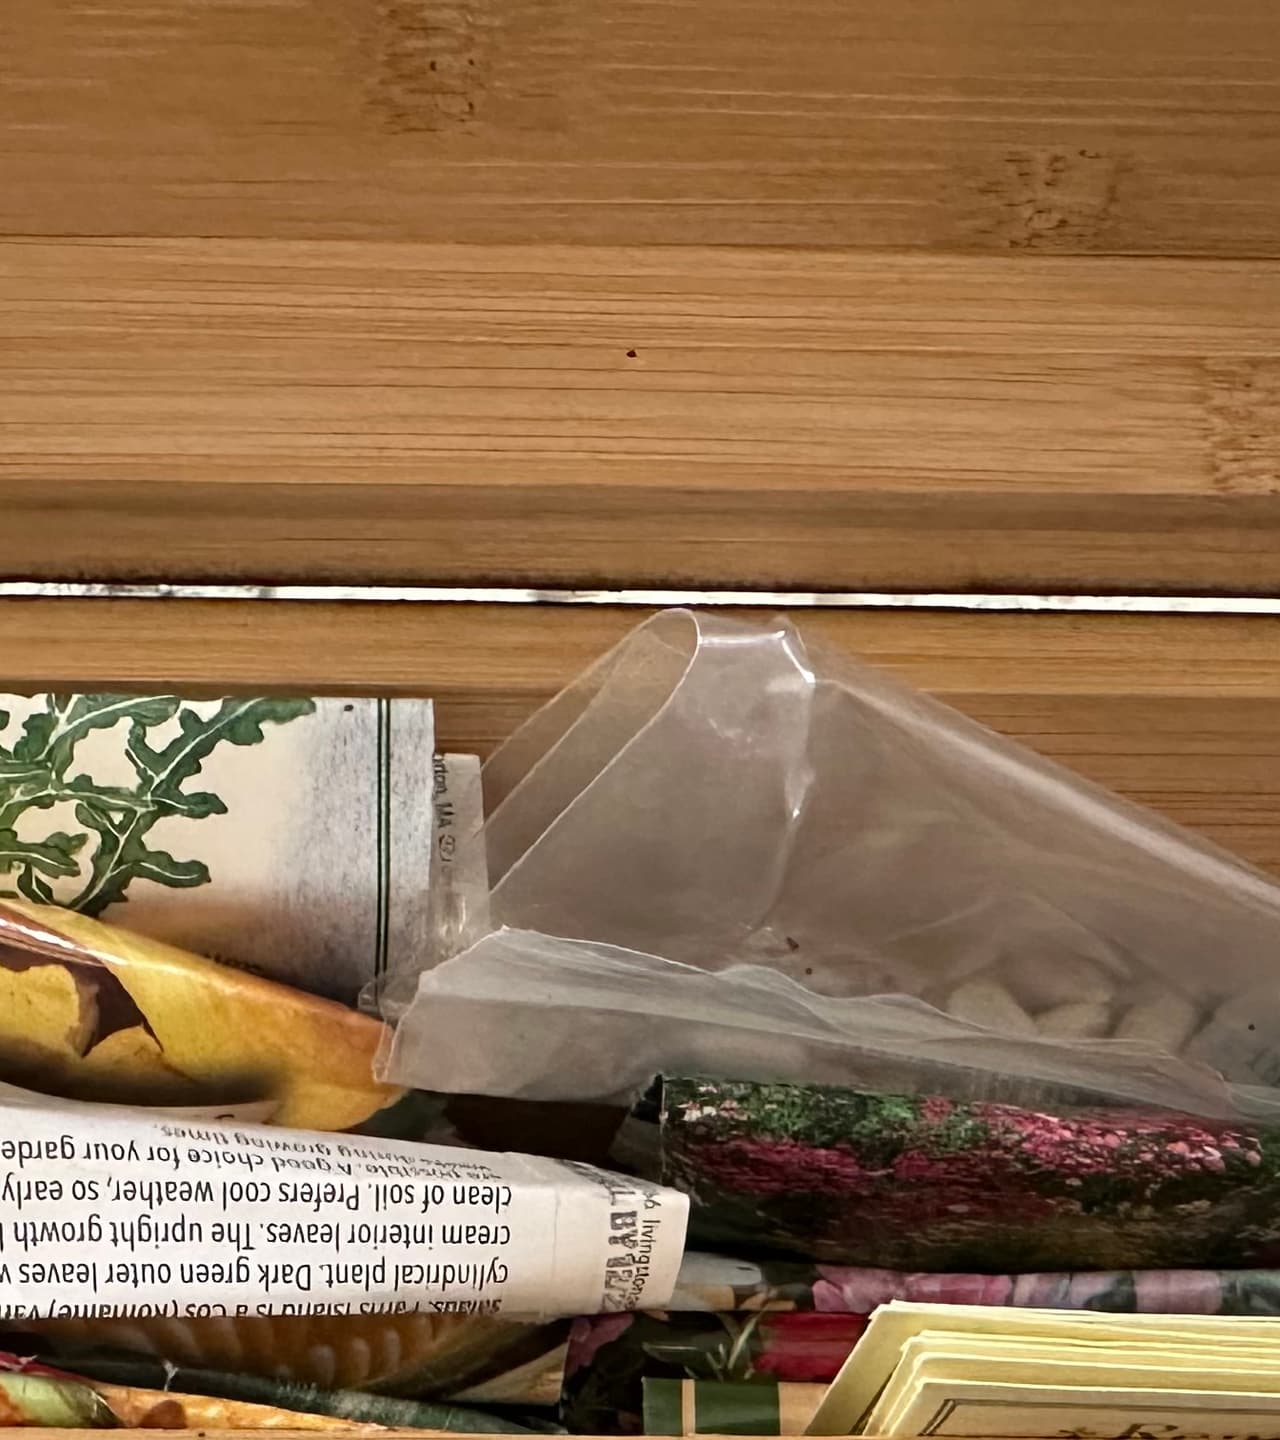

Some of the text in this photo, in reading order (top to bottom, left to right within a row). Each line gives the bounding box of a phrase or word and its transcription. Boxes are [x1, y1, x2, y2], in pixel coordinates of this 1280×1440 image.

[82, 1140, 141, 1163] your
[146, 1146, 181, 1171] for
[187, 1149, 264, 1173] choice
[270, 1156, 332, 1173] good
[335, 1162, 353, 1177] A
[1, 1172, 64, 1211] early
[72, 1180, 100, 1201] so
[107, 1177, 215, 1211] weather,
[223, 1181, 271, 1212] cool
[278, 1182, 360, 1213] Prefers
[367, 1183, 416, 1213] soil.
[420, 1184, 445, 1214] of
[453, 1185, 512, 1215] clean
[13, 1213, 103, 1253] growth
[109, 1213, 203, 1253] upright
[211, 1223, 257, 1252] The
[259, 1222, 340, 1254] leaves.
[346, 1223, 434, 1251] interior
[442, 1224, 511, 1246] cream
[18, 1262, 98, 1295] leaves
[104, 1263, 172, 1289] outer
[180, 1256, 250, 1284] green
[257, 1263, 312, 1293] Dark
[395, 1256, 509, 1292] cylindrical
